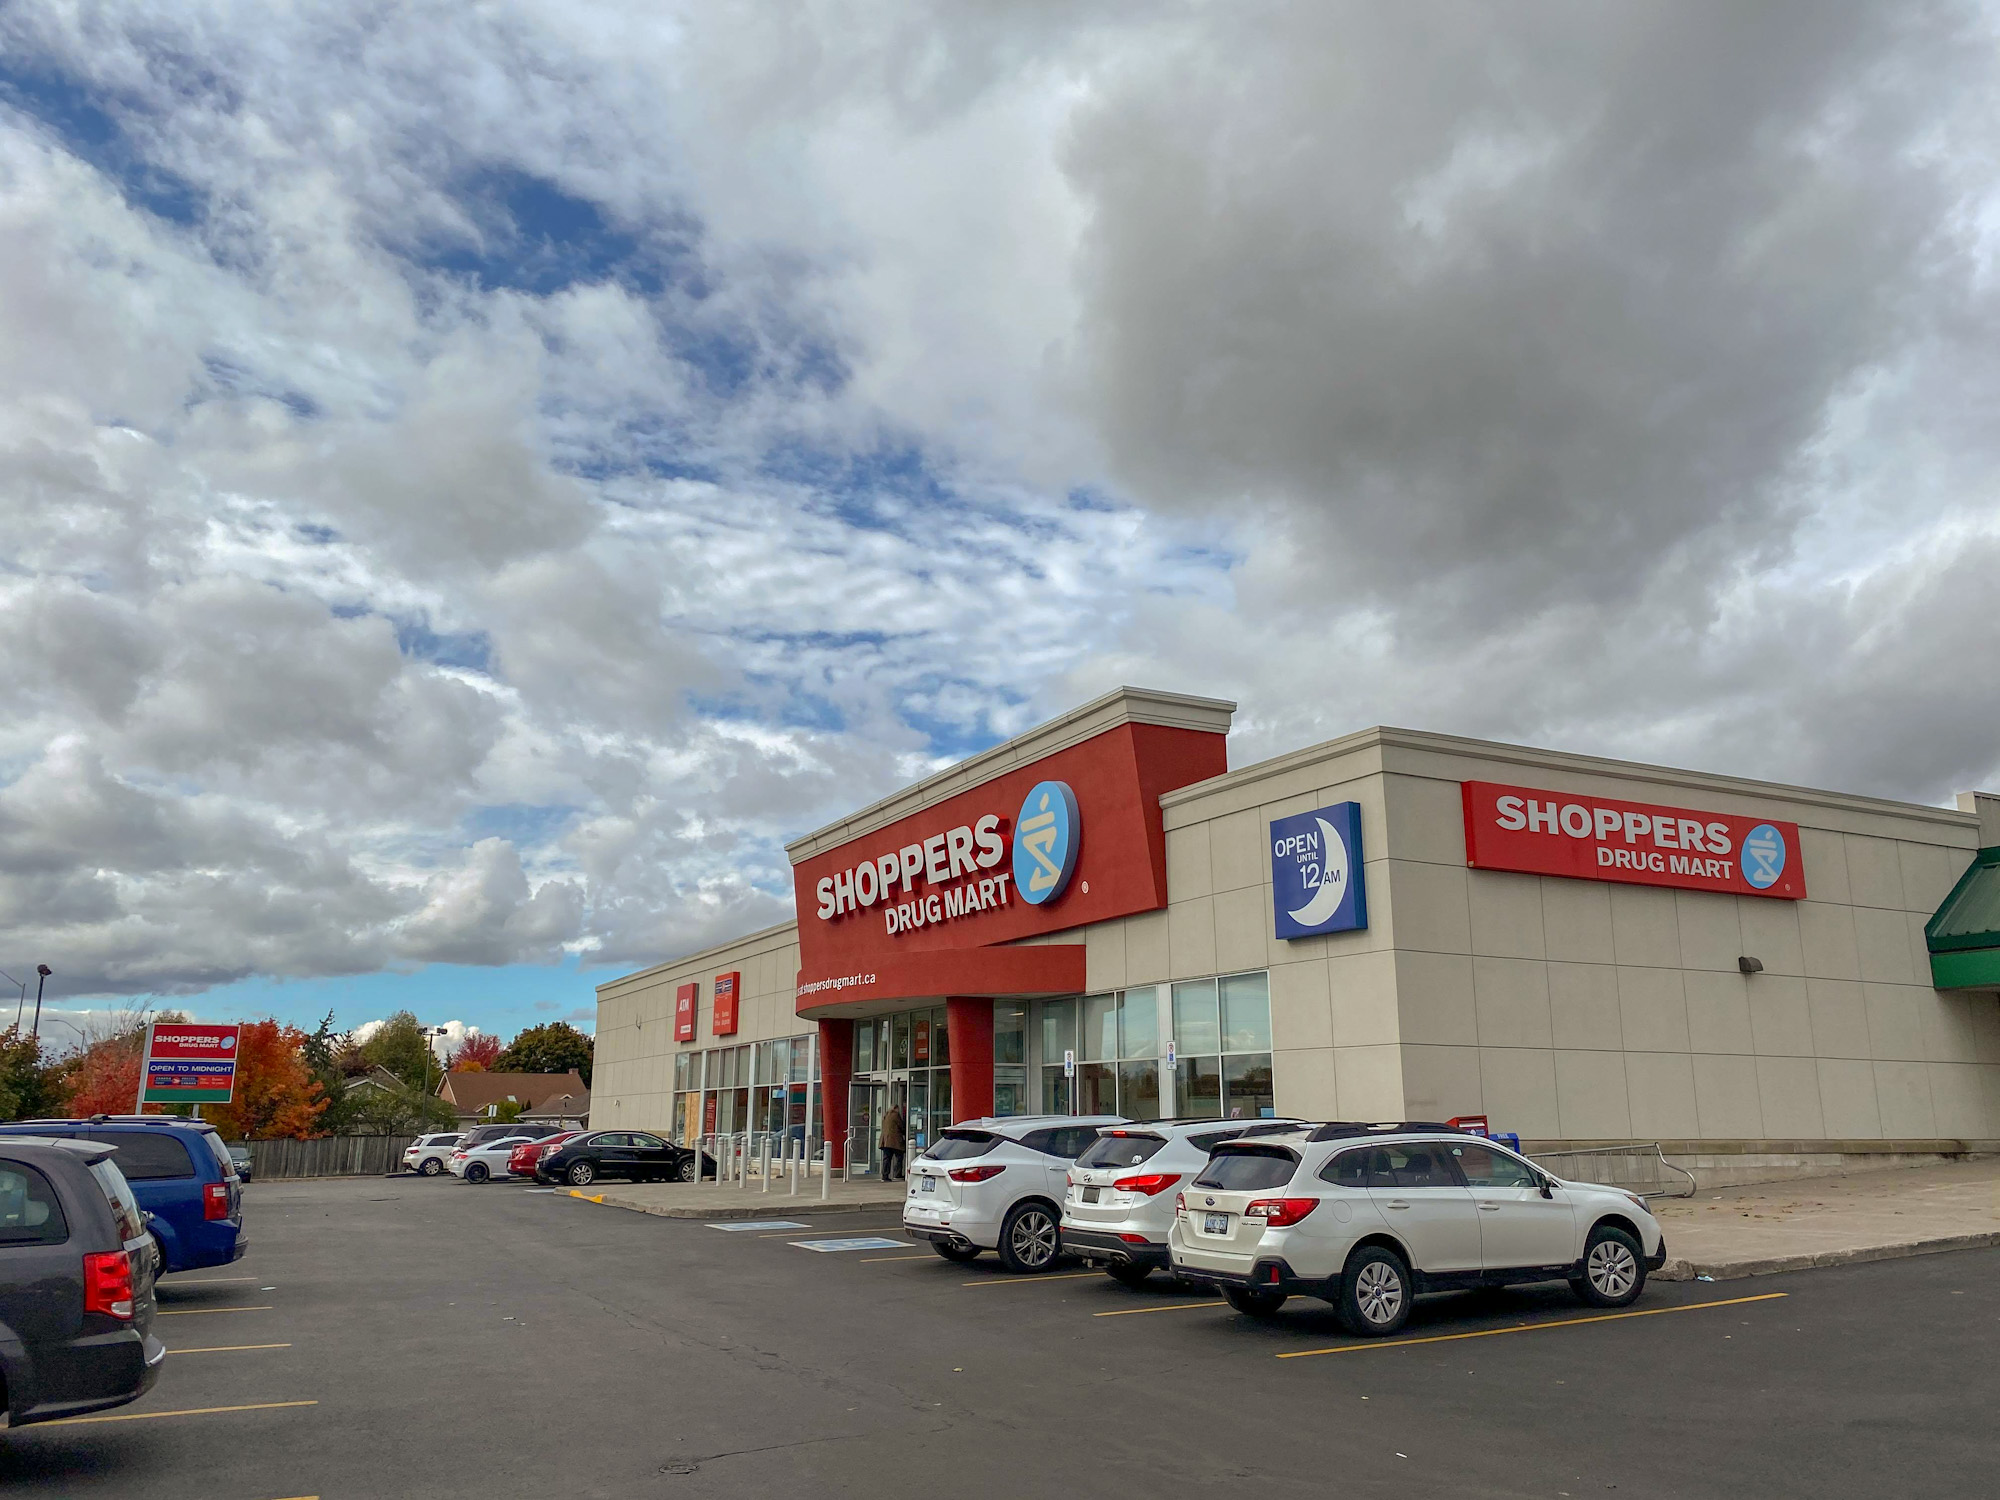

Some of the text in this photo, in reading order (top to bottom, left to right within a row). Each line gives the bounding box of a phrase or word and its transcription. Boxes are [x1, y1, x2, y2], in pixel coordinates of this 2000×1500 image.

[1495, 795, 1732, 855] SHOPPERS
[1274, 831, 1319, 858] OPEN
[1296, 851, 1319, 864] UNTIL
[816, 814, 1005, 920] SHOPPERS
[1299, 862, 1341, 889] 12 AM
[1597, 847, 1734, 880] DRUG MART
[884, 873, 1011, 936] DRUG MART
[155, 1035, 219, 1043] SHOPPERS
[191, 1065, 232, 1073] MIDNIGHT
